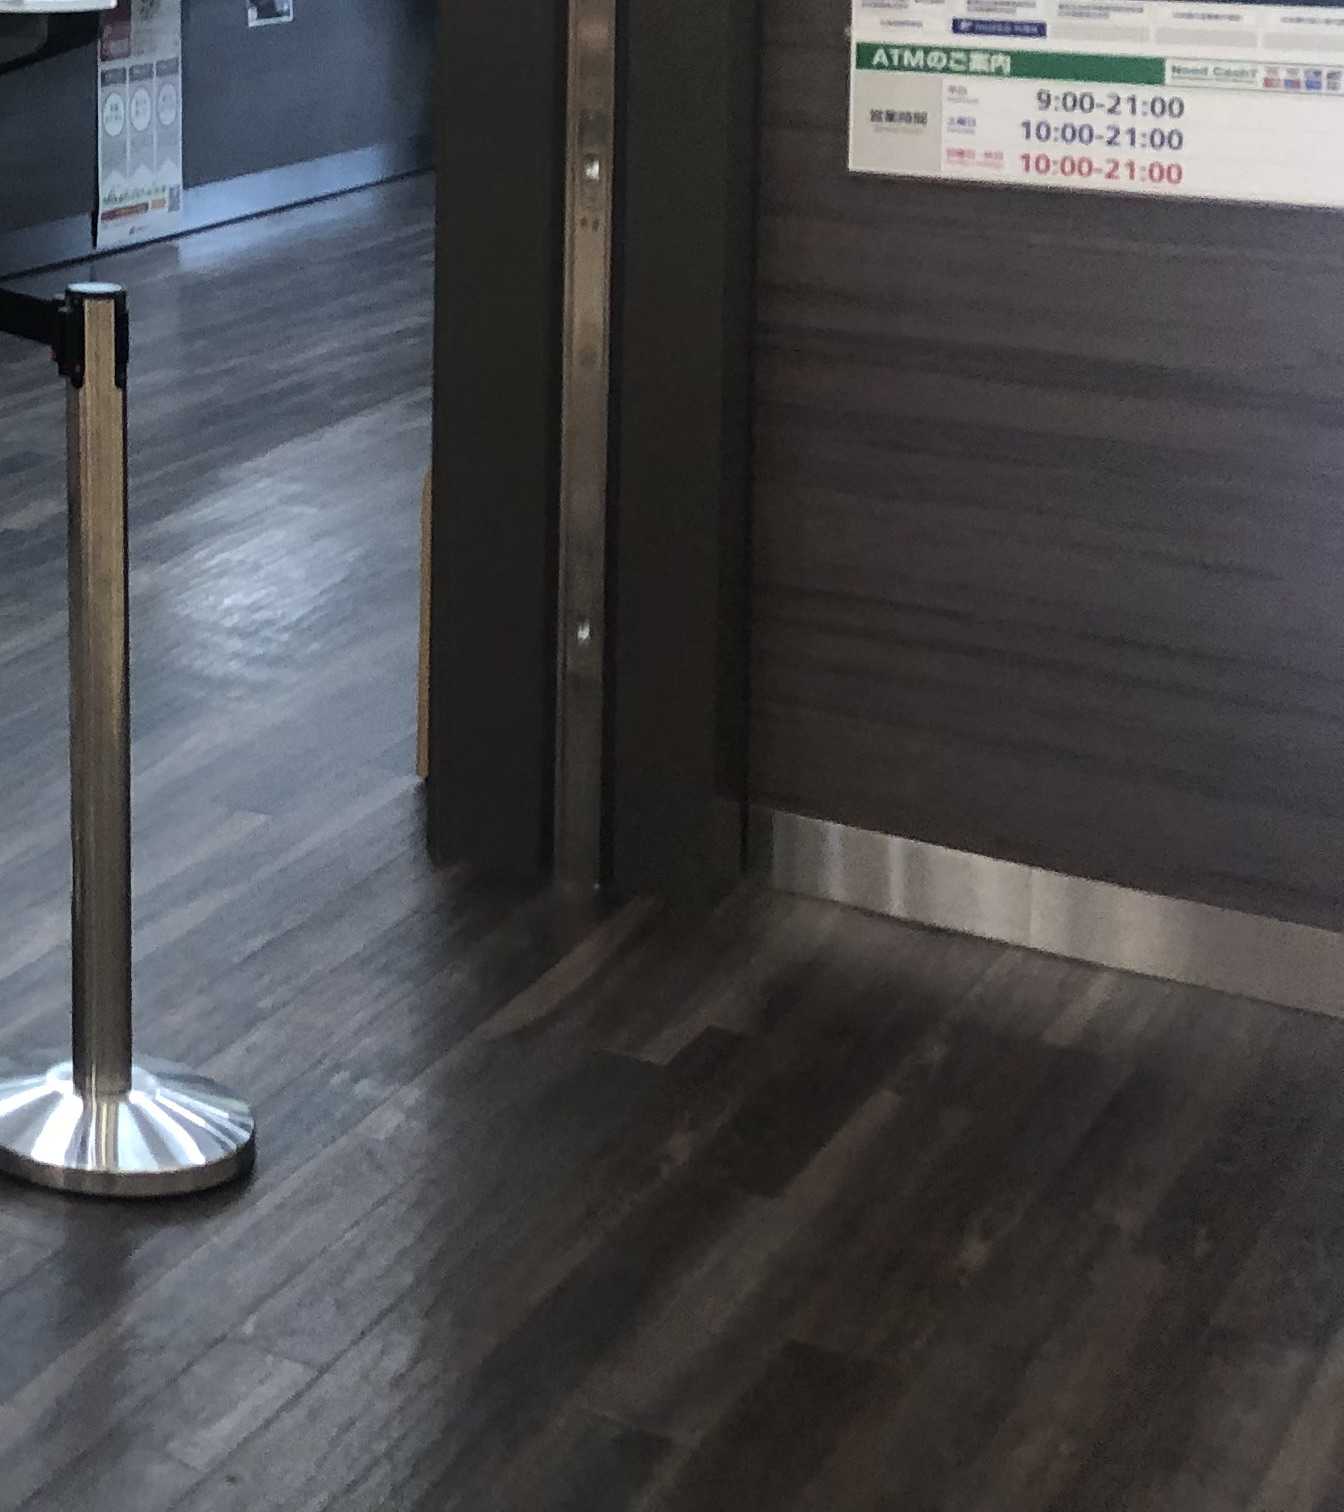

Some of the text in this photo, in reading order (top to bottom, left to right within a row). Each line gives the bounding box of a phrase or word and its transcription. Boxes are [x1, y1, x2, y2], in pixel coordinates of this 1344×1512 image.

[872, 47, 1012, 76] ATMのご案内
[1037, 89, 1185, 119] 9:00-21:00
[1021, 120, 1184, 151] 10:00-21:00
[1020, 153, 1183, 185] 10:00-21:00
